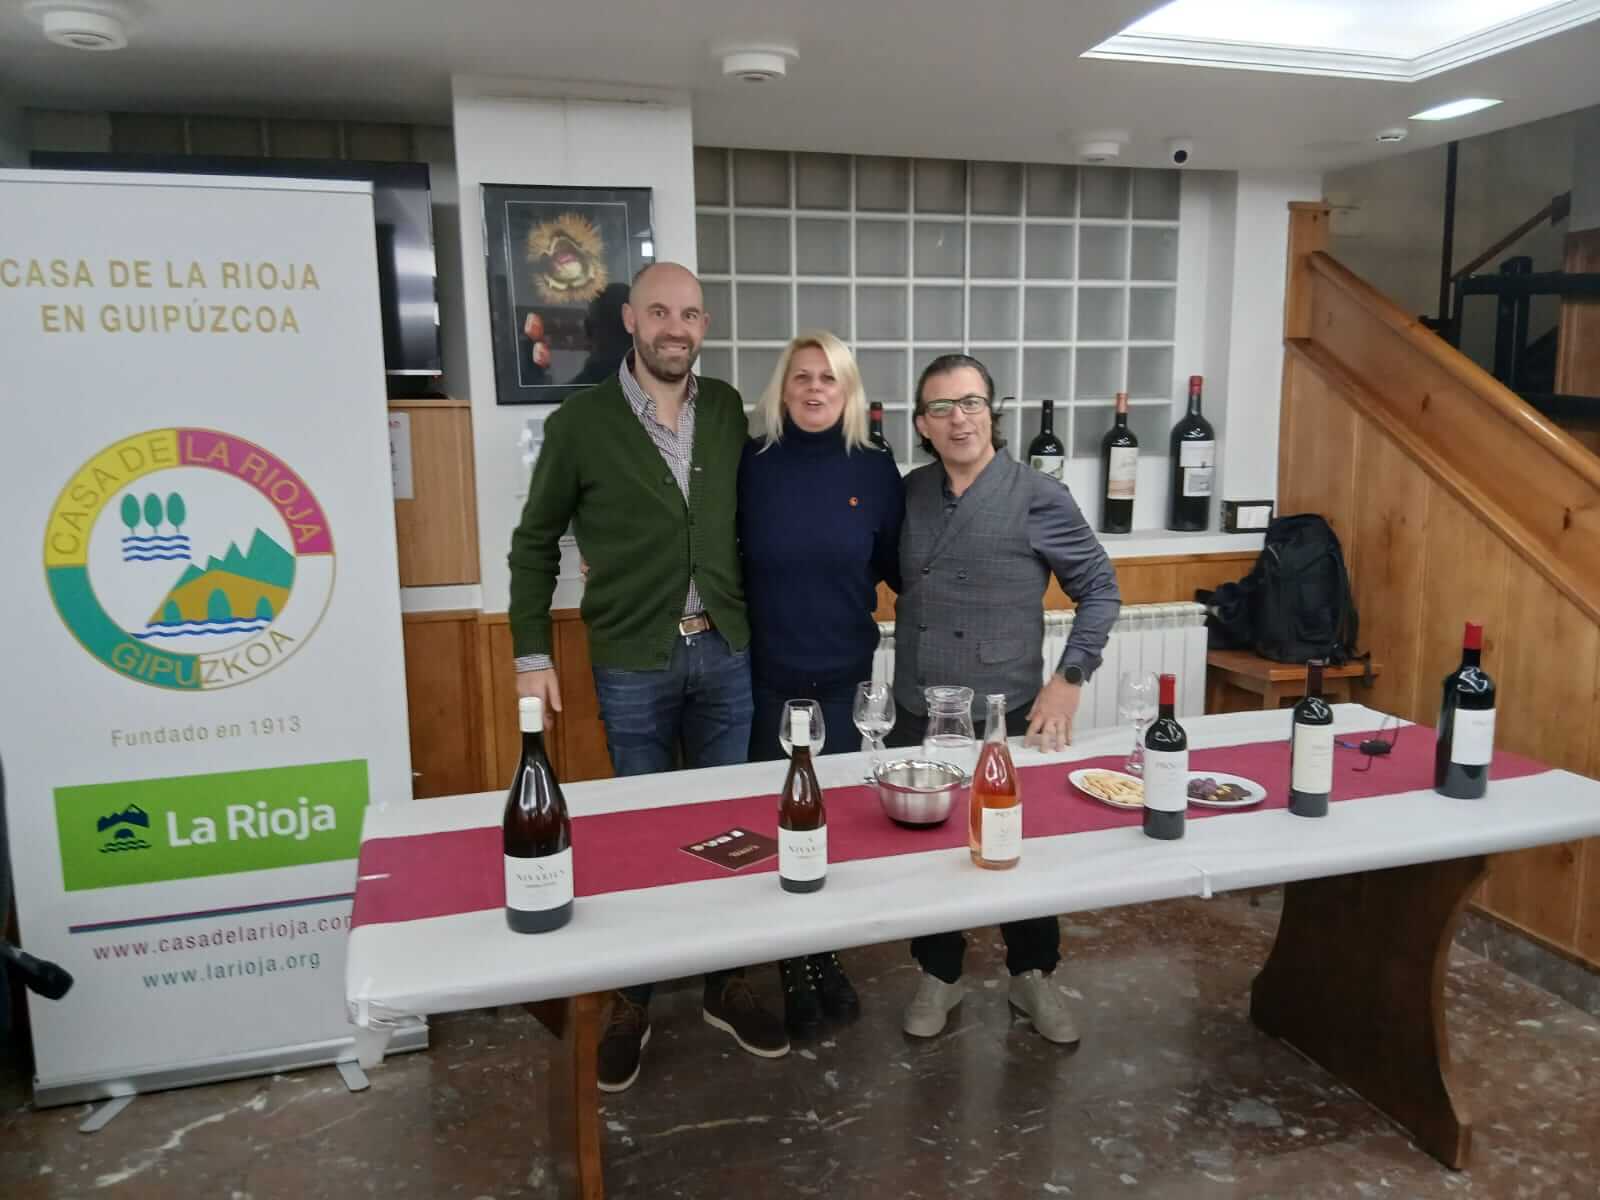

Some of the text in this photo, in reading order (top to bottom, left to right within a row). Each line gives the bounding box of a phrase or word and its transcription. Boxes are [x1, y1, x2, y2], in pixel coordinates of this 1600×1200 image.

[1, 258, 321, 291] CASA DE LA RIOJA
[41, 298, 300, 334] EN GUIPÚZCOA
[50, 465, 120, 556] CASA
[119, 437, 173, 473] DE
[185, 435, 231, 467] LA
[239, 453, 321, 544] RIOJA
[111, 628, 295, 686] GIPUZKOA
[111, 715, 302, 748] Fundado en 1913
[167, 798, 336, 847] La Rioja
[142, 951, 321, 989] www.larioja.org
